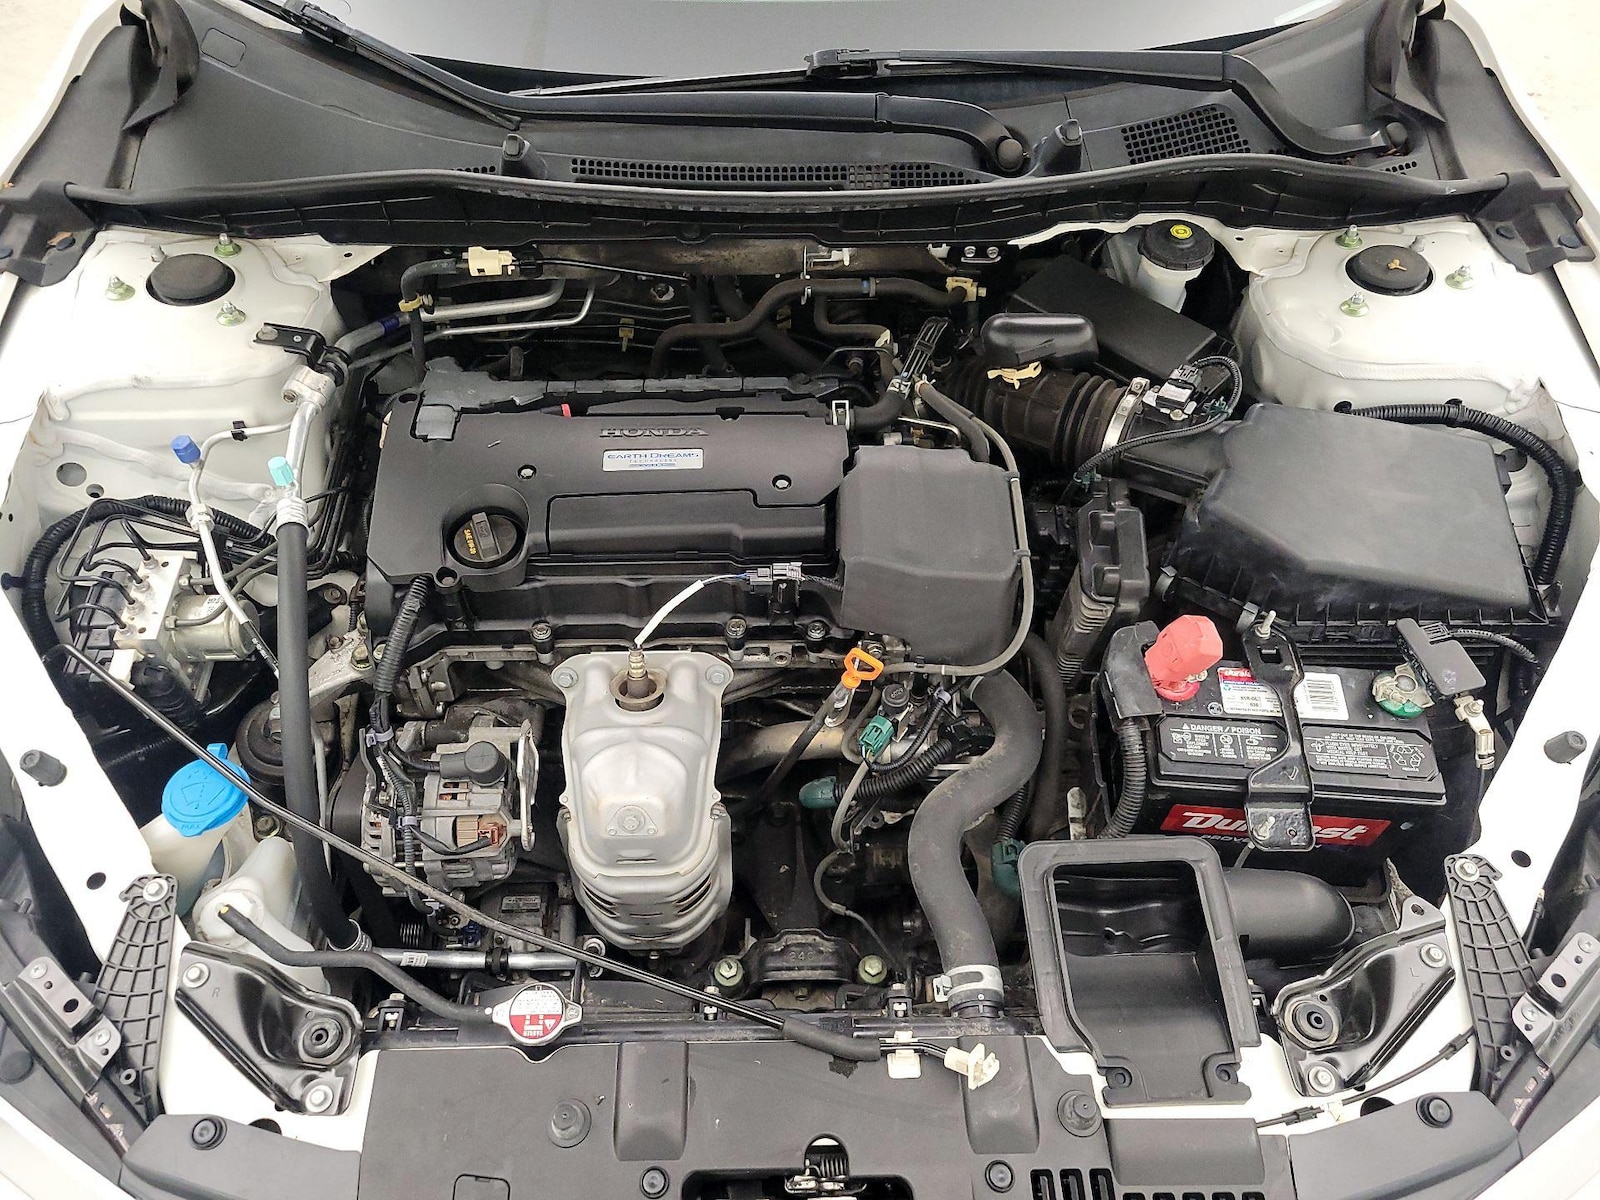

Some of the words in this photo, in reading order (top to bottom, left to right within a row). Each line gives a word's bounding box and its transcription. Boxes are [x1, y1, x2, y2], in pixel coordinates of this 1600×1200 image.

[599, 428, 709, 437] HONDA
[1190, 724, 1223, 732] DANGER
[1231, 727, 1261, 735] POISON
[211, 986, 221, 998] R
